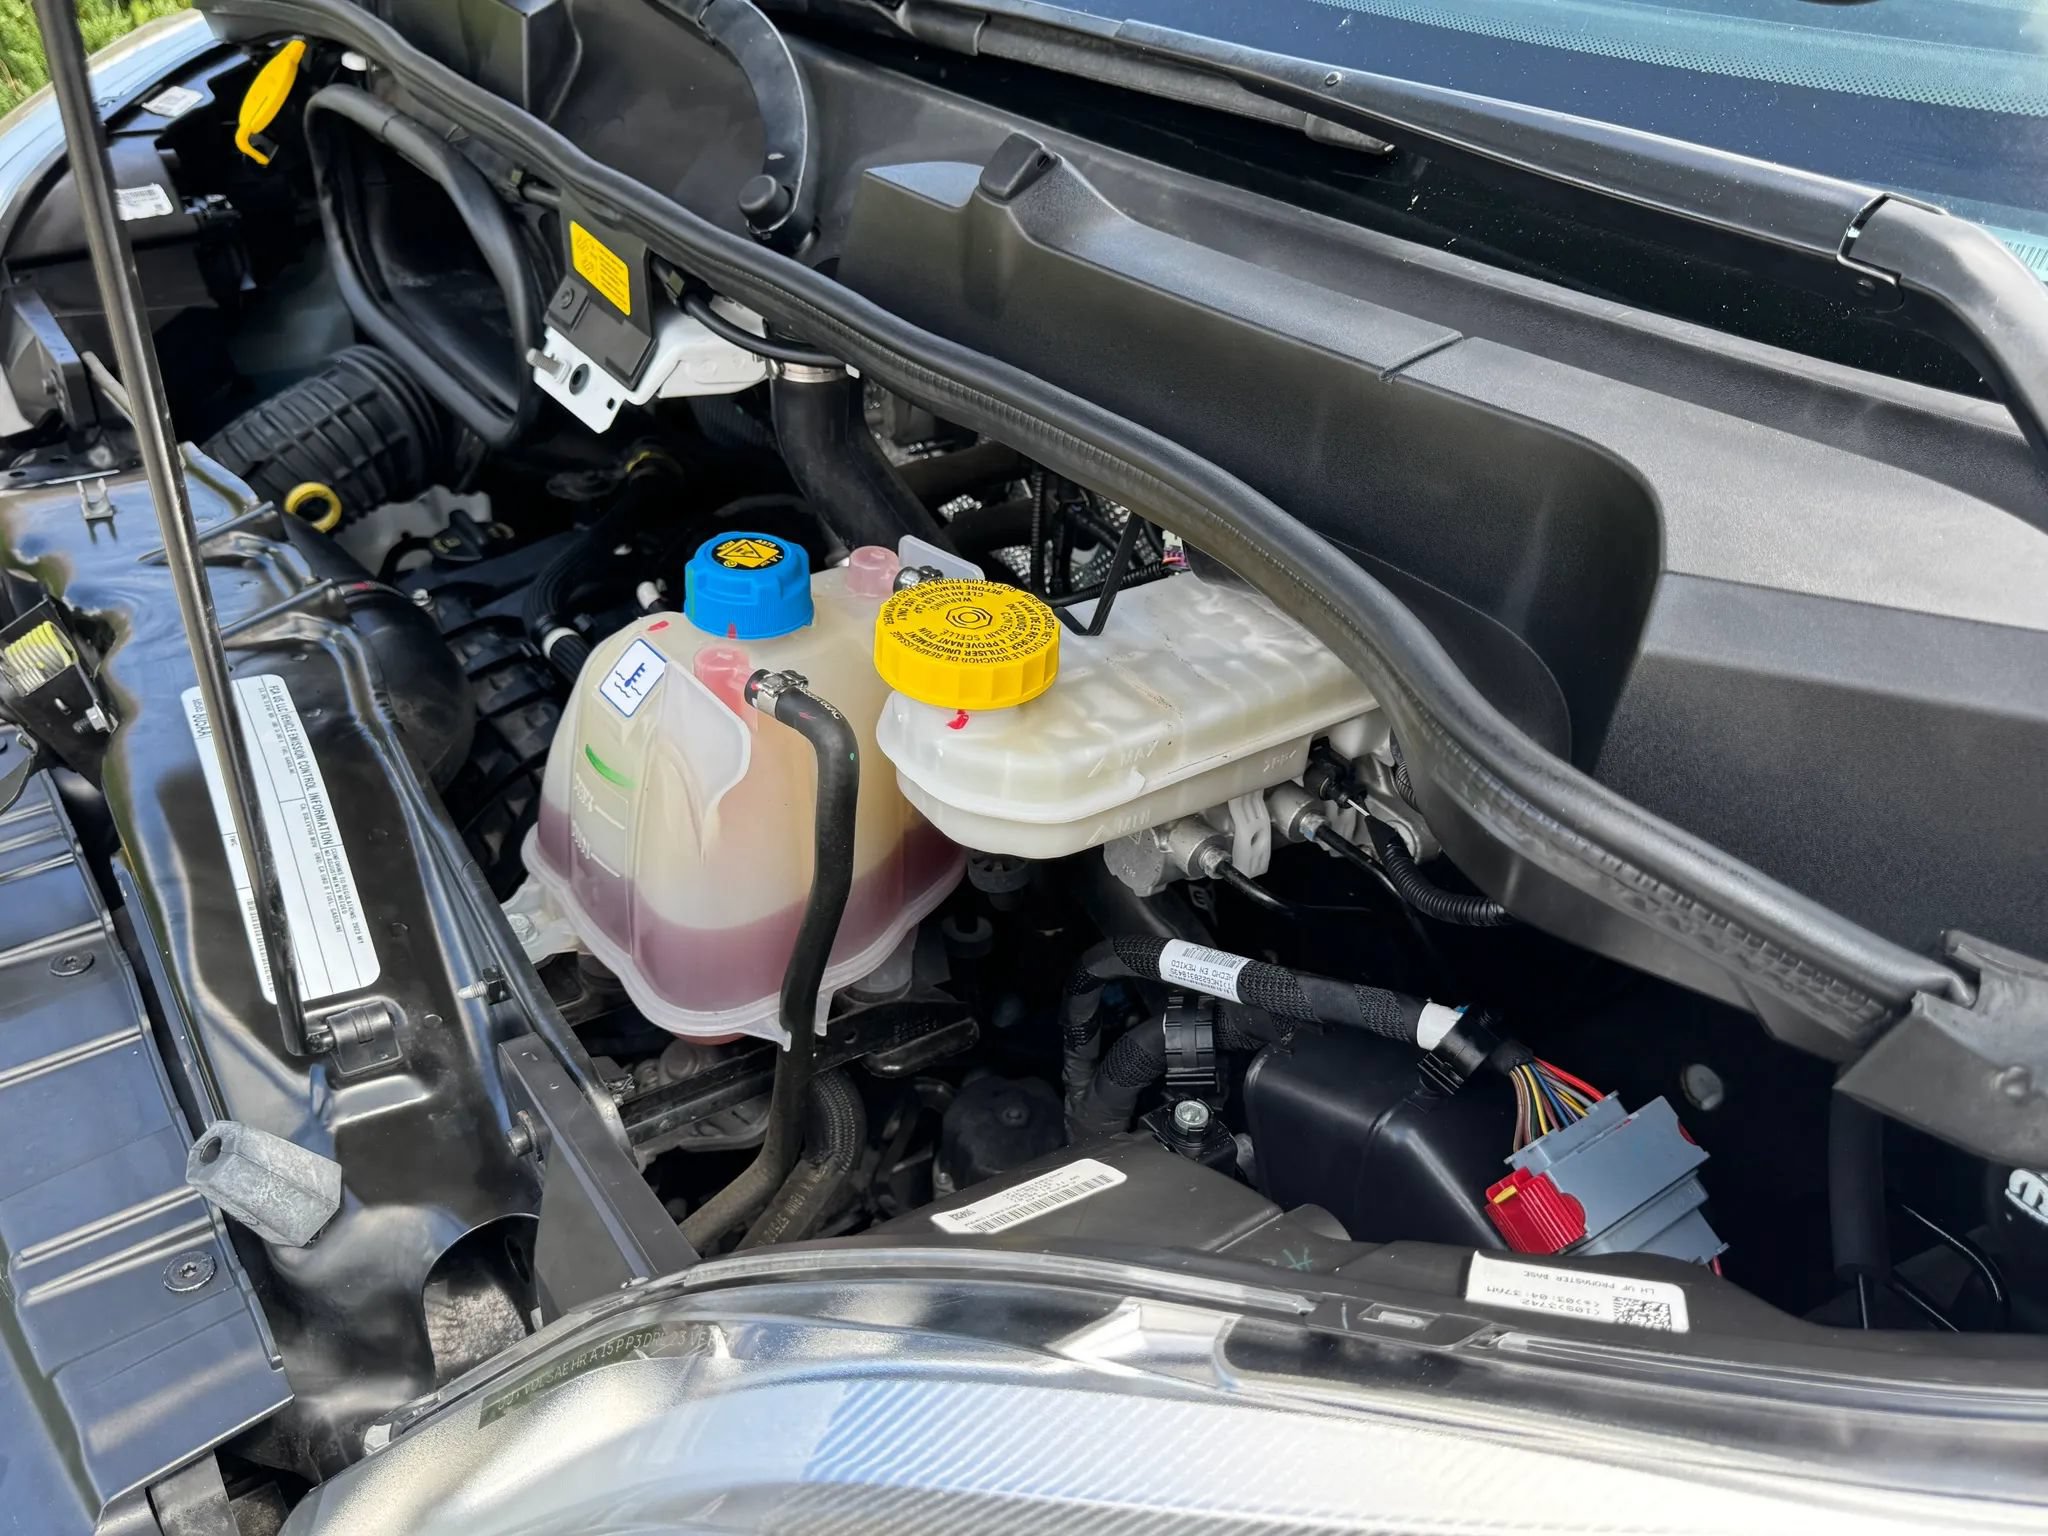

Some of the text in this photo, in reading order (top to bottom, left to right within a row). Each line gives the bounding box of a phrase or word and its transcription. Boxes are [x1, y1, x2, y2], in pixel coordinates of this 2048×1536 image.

[936, 578, 961, 586] FROM
[951, 590, 984, 598] CLEAN
[966, 585, 1003, 596] BEFORE
[1000, 584, 1017, 593] DOT
[983, 611, 1014, 640] CONTENANT
[1030, 616, 1042, 625] DE
[1030, 624, 1042, 632] LE
[1005, 629, 1023, 642] DOT
[888, 630, 944, 660] REMPLISSAGE
[905, 631, 962, 656] UNIQUEMENT
[937, 637, 1000, 649] PROVENANT
[964, 647, 1009, 657] UTILISER
[1011, 651, 1025, 660] LE
[945, 655, 959, 663] DE
[961, 654, 1013, 664] BOUCHON
[280, 713, 297, 734] VEHICLE
[287, 733, 307, 760] EMISSION
[297, 759, 317, 792] CONTROL
[308, 792, 335, 846] INFORMATION
[1170, 959, 1234, 981] HECHO EN MEXICO
[1523, 1269, 1550, 1281] BASE
[1555, 1276, 1617, 1290] PROMASTER
[546, 1361, 570, 1384] SAE
[571, 1355, 588, 1371] HR
[589, 1348, 598, 1363] A
